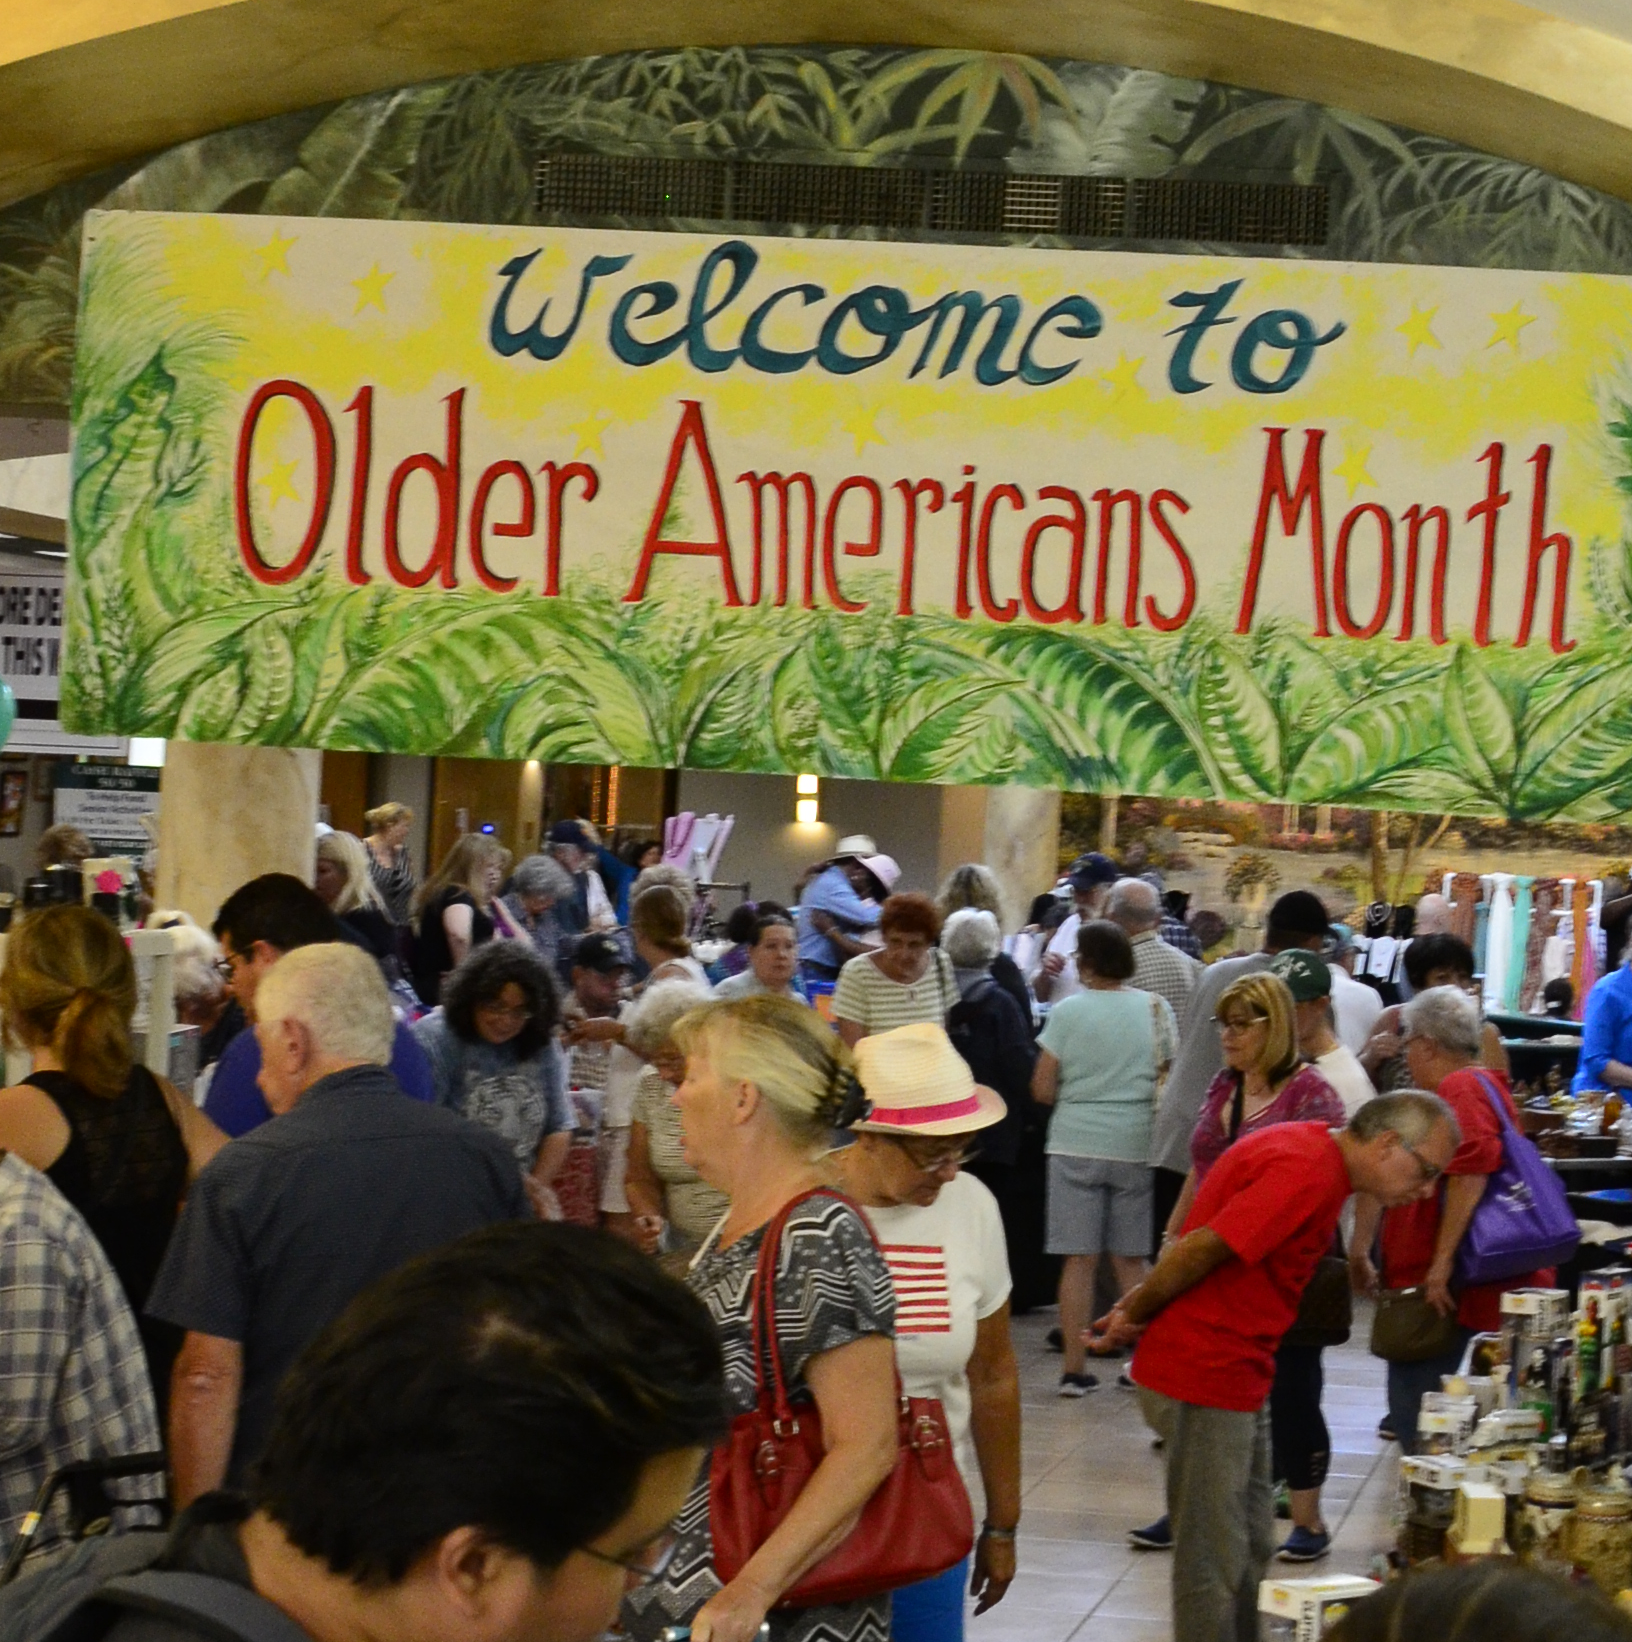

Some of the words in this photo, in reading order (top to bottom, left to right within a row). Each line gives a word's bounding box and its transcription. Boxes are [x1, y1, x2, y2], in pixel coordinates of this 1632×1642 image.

[490, 239, 1102, 387] Welcome
[1164, 278, 1346, 395] to
[235, 379, 599, 597] Older
[622, 400, 1196, 632] Americans
[1236, 427, 1575, 654] Month
[34, 588, 62, 626] DE
[2, 637, 42, 675] THIS
